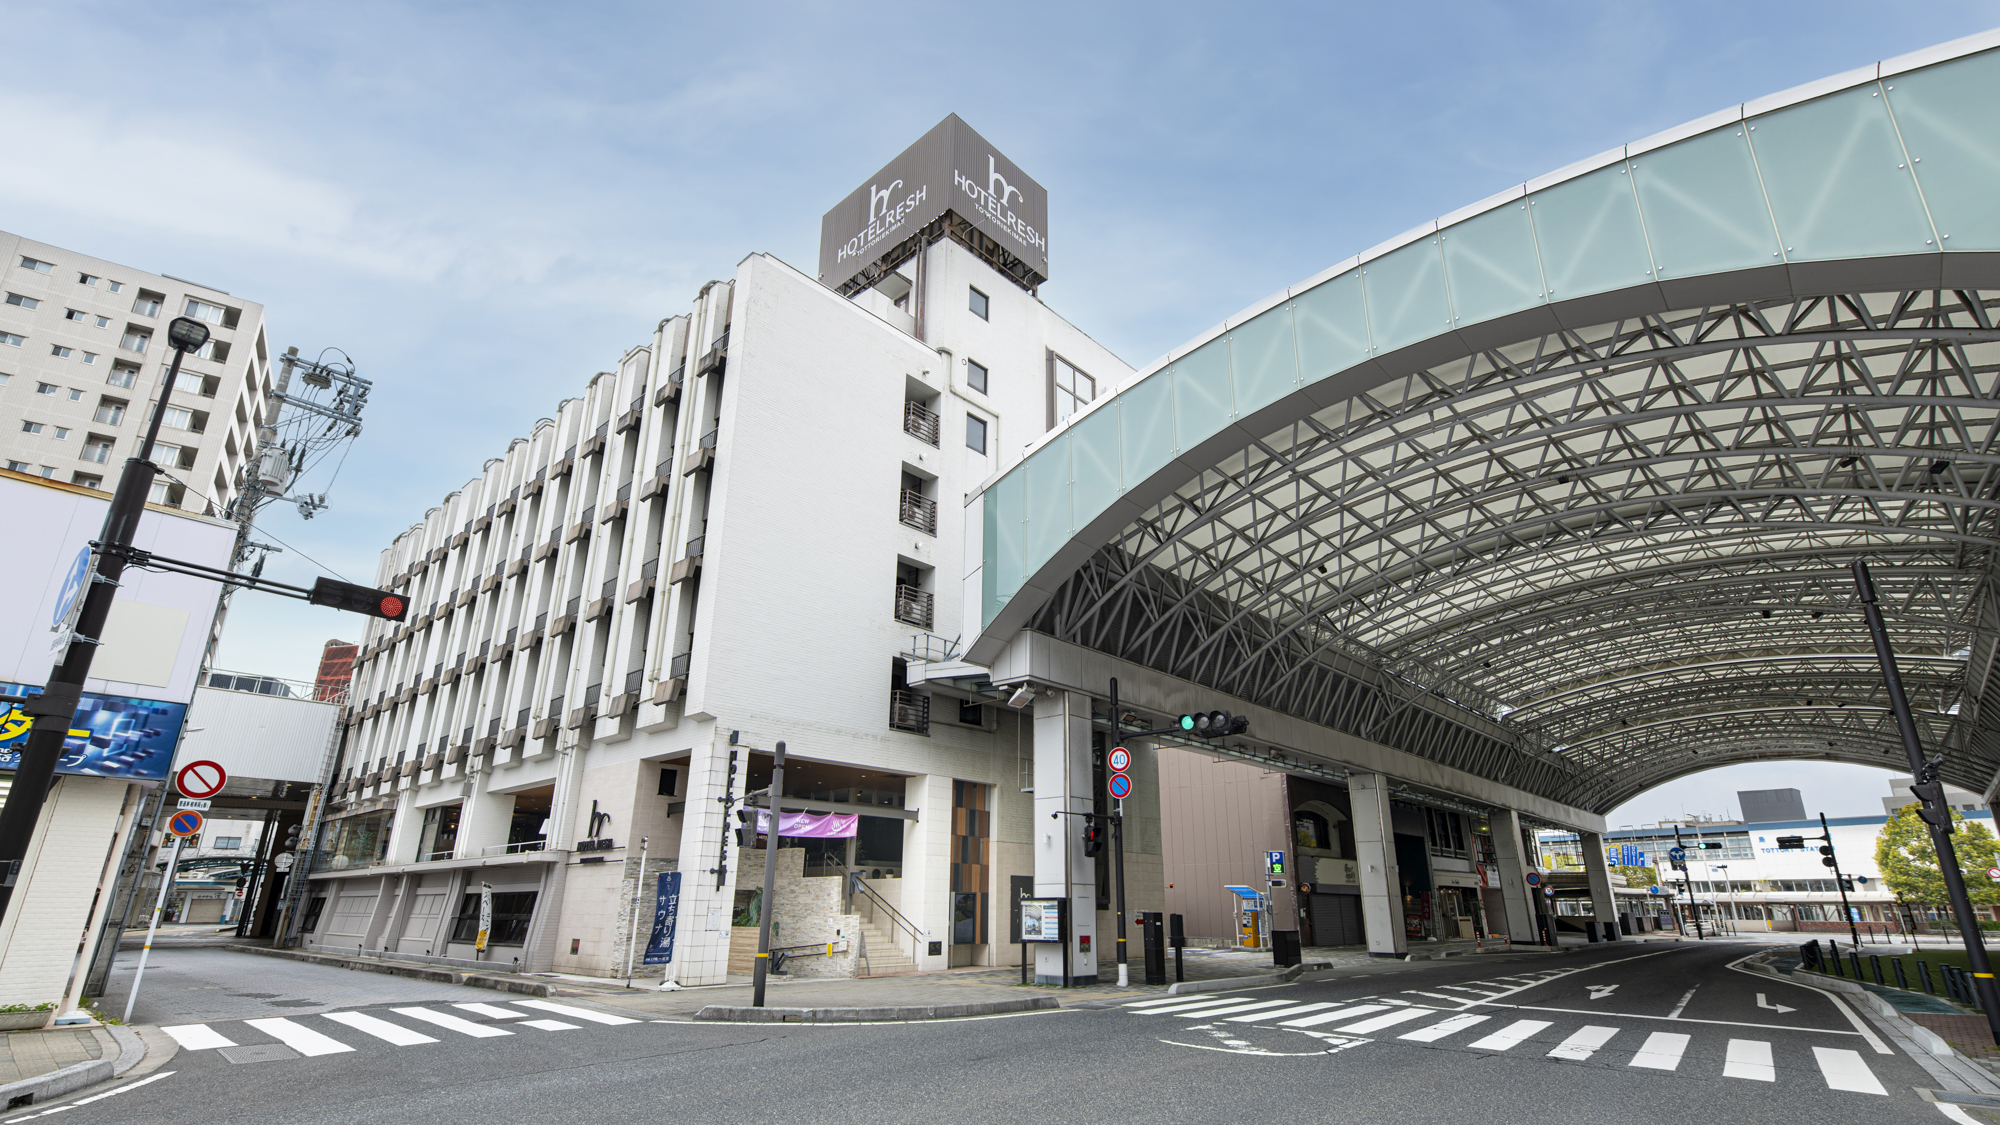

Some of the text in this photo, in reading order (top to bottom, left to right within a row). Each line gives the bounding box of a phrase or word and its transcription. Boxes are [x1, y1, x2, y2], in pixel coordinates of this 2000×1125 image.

[1113, 754, 1126, 765] 40
[1272, 852, 1280, 862] P
[1273, 864, 1282, 873] 空
[655, 895, 667, 935] サウナ
[660, 894, 678, 948] 立ち寄り湯
